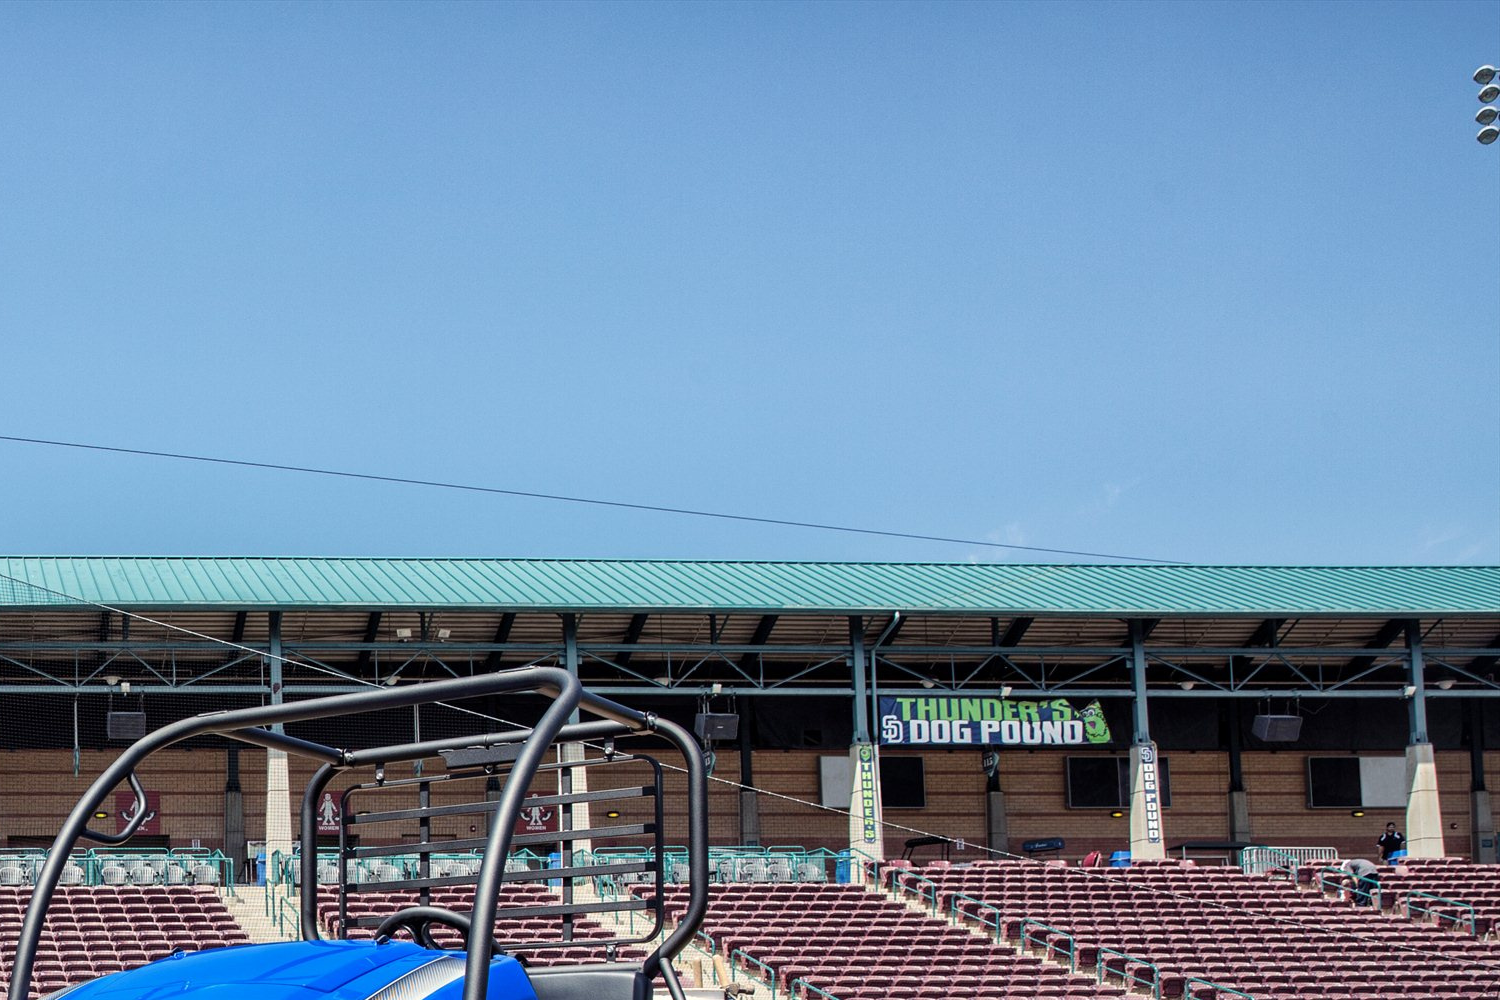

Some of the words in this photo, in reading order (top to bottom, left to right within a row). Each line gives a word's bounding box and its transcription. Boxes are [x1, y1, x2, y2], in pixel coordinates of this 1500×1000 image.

[896, 698, 1072, 722] THUNDER'S
[910, 719, 972, 744] DOG
[980, 719, 1083, 744] POUND
[1143, 763, 1155, 790] DOG
[861, 762, 876, 839] THUNDER'S
[1145, 793, 1159, 838] POUND
